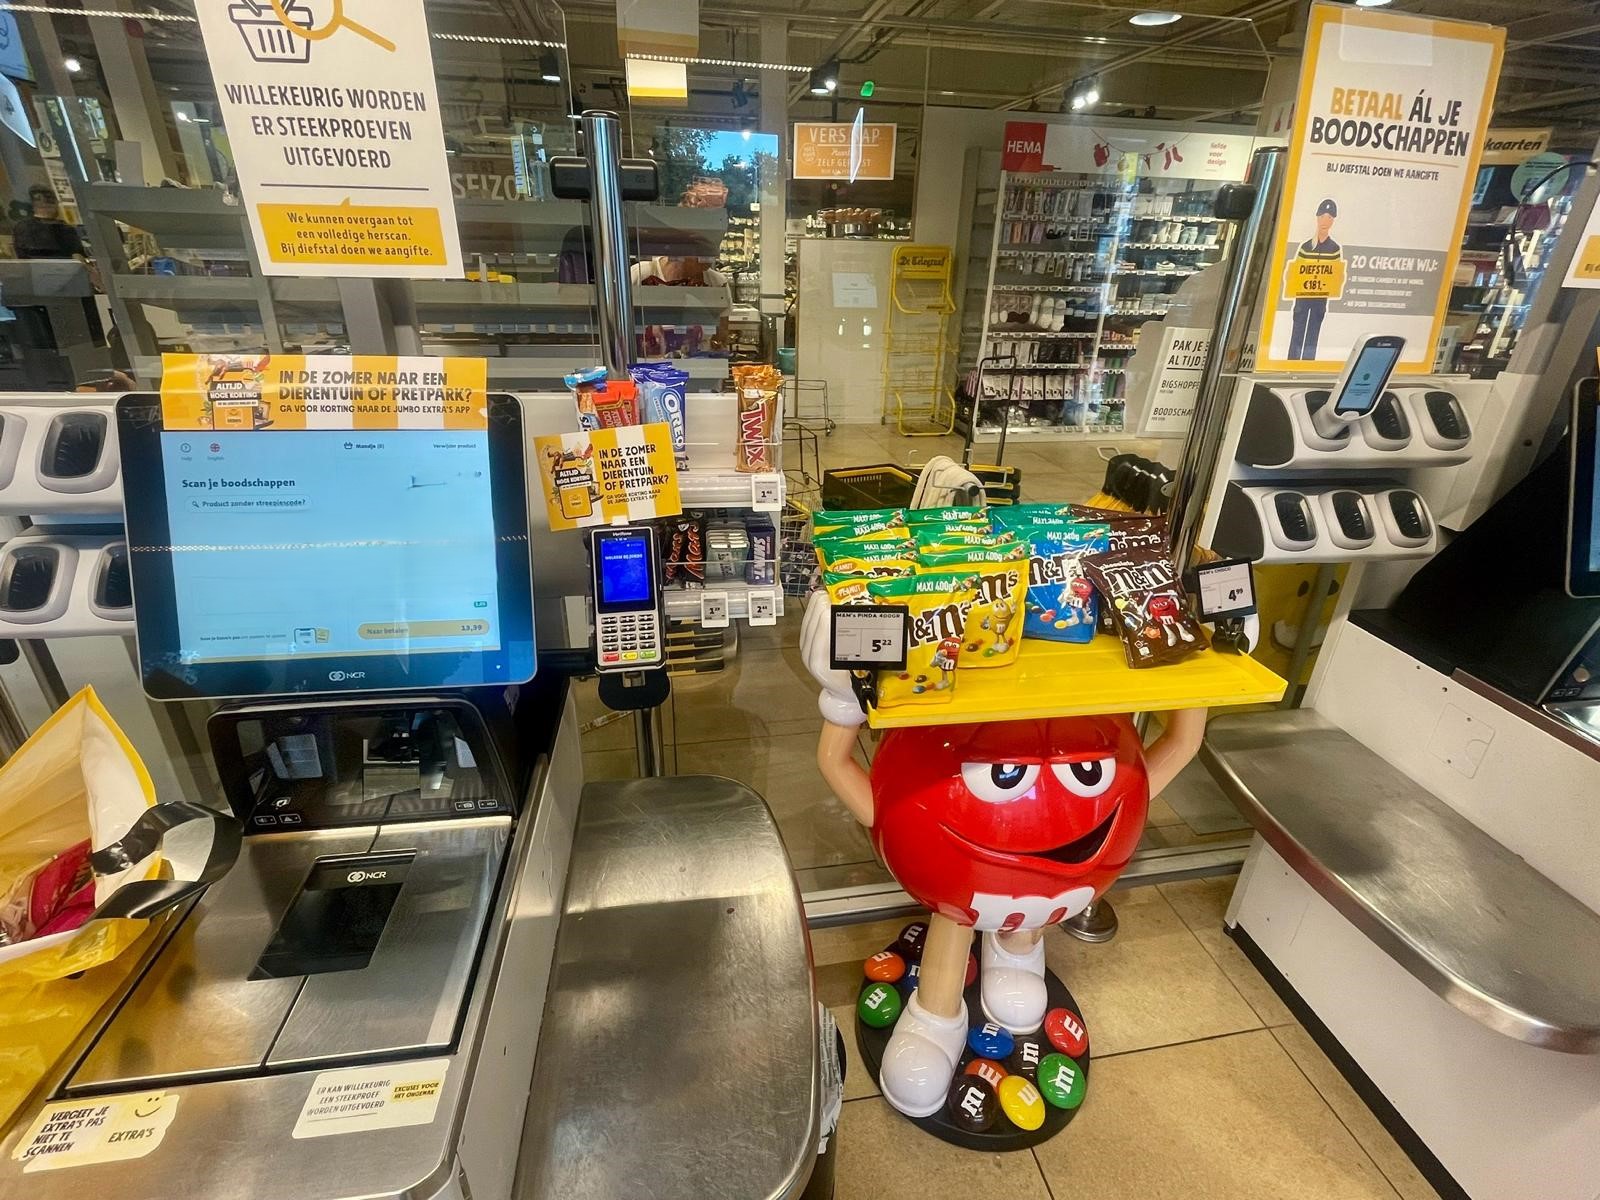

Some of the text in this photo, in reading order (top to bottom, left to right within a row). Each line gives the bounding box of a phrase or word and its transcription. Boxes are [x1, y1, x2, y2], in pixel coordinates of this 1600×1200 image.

[224, 84, 427, 112] WILLEKEURIG WORDEN
[1330, 87, 1462, 126] BETAAL ÁL JE
[251, 116, 412, 140] ER STEEKPROEVEN
[1310, 116, 1470, 156] BOODSCHAPPEN
[1007, 140, 1042, 154] HEMA
[284, 146, 391, 168] UITGEVOERD
[1326, 162, 1439, 181] BIJ DIEFSTAL DOEN WE AANGIFTE
[287, 212, 414, 228] We kunnen overgaan tot
[296, 229, 411, 242] een volledige herscan.
[281, 242, 433, 259] Bij diefstal doen we aangifte.
[1300, 265, 1333, 275] DIEFSTAL
[1351, 255, 1367, 269] ZO
[1369, 255, 1415, 272] CHECKEN
[1172, 340, 1191, 351] PAK
[1192, 340, 1204, 352] JE
[279, 370, 448, 386] IN DE ZOMER NAAR EEN
[216, 382, 243, 390] ALTIJD
[279, 386, 472, 403] DIERENTUIN OF PRETPARK?
[280, 405, 470, 414] GA VOOR KORTING NAAR DE JUMBO EXTRA'S APP
[664, 393, 685, 448] OREO
[741, 402, 766, 468] TWIX
[599, 444, 656, 459] IN DE ZOMER
[601, 456, 646, 470] NAAR EEN
[603, 466, 654, 480] DIERENTUIN
[182, 478, 296, 490] Scan je boodschappen
[604, 482, 617, 491] OF
[619, 474, 669, 490] PRETPARK?
[231, 499, 254, 507] zonder
[964, 536, 981, 545] MAXI
[1047, 531, 1062, 541] MAXI
[968, 551, 1003, 562] MAXI 400g
[917, 581, 934, 592] MAXI
[346, 672, 366, 680] NCR
[366, 871, 387, 880] NCR
[316, 1079, 391, 1095] ER KAN WILLEKEURIG
[394, 1082, 440, 1093] EXCUSES VOOR
[394, 1089, 435, 1100] HET ONGEMAK
[320, 1090, 381, 1105] EEN STEEKPROEF
[50, 1106, 111, 1122] VERGEET JE
[307, 1100, 385, 1117] WORDEN UITGEVOERD
[41, 1117, 107, 1134] EXTRA'S PAS
[32, 1131, 73, 1146] NIET TE
[108, 1127, 156, 1144] EXTRA'S
[22, 1142, 75, 1159] SCANNEN
